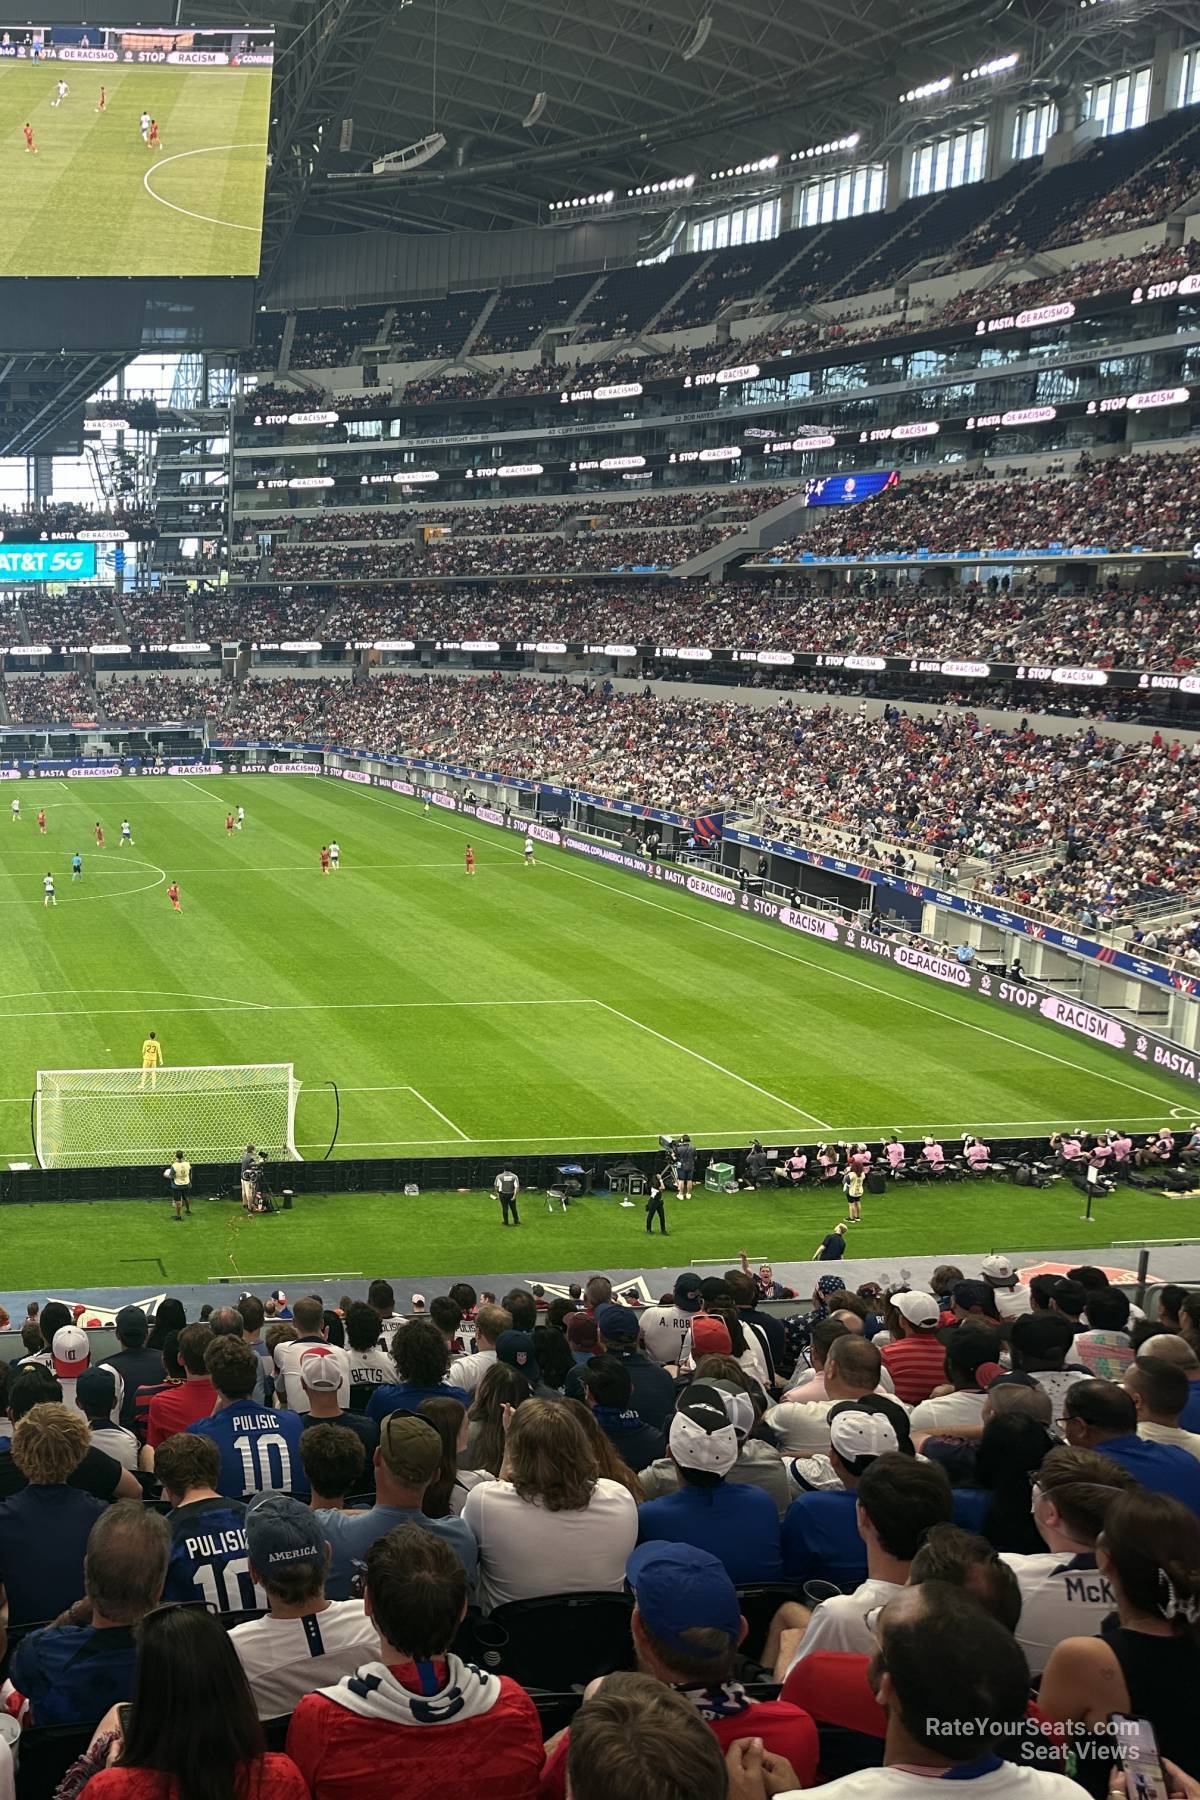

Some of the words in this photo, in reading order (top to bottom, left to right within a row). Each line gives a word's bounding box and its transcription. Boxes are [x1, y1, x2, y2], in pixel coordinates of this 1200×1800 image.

[77, 52, 114, 60] RACISMO
[138, 52, 166, 62] STOP
[178, 54, 216, 63] RACISM
[1148, 282, 1178, 299] STOP
[988, 318, 1014, 330] BASTA
[1020, 312, 1032, 324] DE
[1033, 306, 1070, 321] RACISMO
[695, 374, 716, 385] STOP
[724, 367, 750, 380] RACISM
[571, 391, 592, 400] BASTA
[608, 384, 639, 395] RACISMO
[1100, 399, 1126, 412] STOP
[1137, 392, 1175, 405] RACISM
[266, 416, 288, 424] STOP
[298, 414, 328, 422] RACISM
[977, 415, 1000, 426] BASTA
[1006, 412, 1016, 422] DE
[1018, 409, 1051, 420] RACISMO
[870, 430, 891, 441] STOP
[901, 425, 927, 436] RACISM
[773, 442, 791, 451] BASTA
[679, 453, 698, 462] STOP
[708, 449, 732, 458] RACISM
[477, 468, 497, 477] STOP
[506, 466, 532, 474] RACISM
[579, 461, 598, 470] BASTA
[50, 552, 84, 570] 5G
[662, 648, 677, 656] STOP
[740, 653, 756, 661] BASTA
[825, 656, 844, 666] STOP
[919, 662, 940, 672] BASTA
[1028, 668, 1051, 680] STOP
[1062, 671, 1094, 681] RACISM
[1152, 676, 1178, 688] BASTA
[1186, 680, 1196, 688] DE
[330, 768, 342, 776] STOP
[348, 770, 365, 781] RACISM
[514, 820, 527, 832] STOP
[534, 827, 553, 840] RACISM
[567, 838, 590, 854] CONMEBOL
[624, 857, 633, 867] USA
[664, 870, 685, 886] BASTA
[691, 878, 701, 891] DE
[701, 881, 733, 903] RACISMO
[753, 898, 777, 918] STOP
[789, 910, 825, 935] RACISM
[860, 936, 890, 957] BASTA
[900, 948, 913, 965] DE
[917, 954, 966, 983] RACISMO
[999, 983, 1037, 1008] STOP
[1056, 1003, 1108, 1038] RACISM
[1154, 1046, 1194, 1078] BASTA
[659, 1317, 668, 1327] A.
[674, 1319, 690, 1328] ROB
[352, 1368, 383, 1383] BETTS
[233, 1414, 279, 1431] PULISIC
[233, 1433, 291, 1495] 10
[268, 1546, 318, 1562] AMERICA
[193, 1558, 268, 1614] 10
[1065, 1578, 1116, 1602] McK
